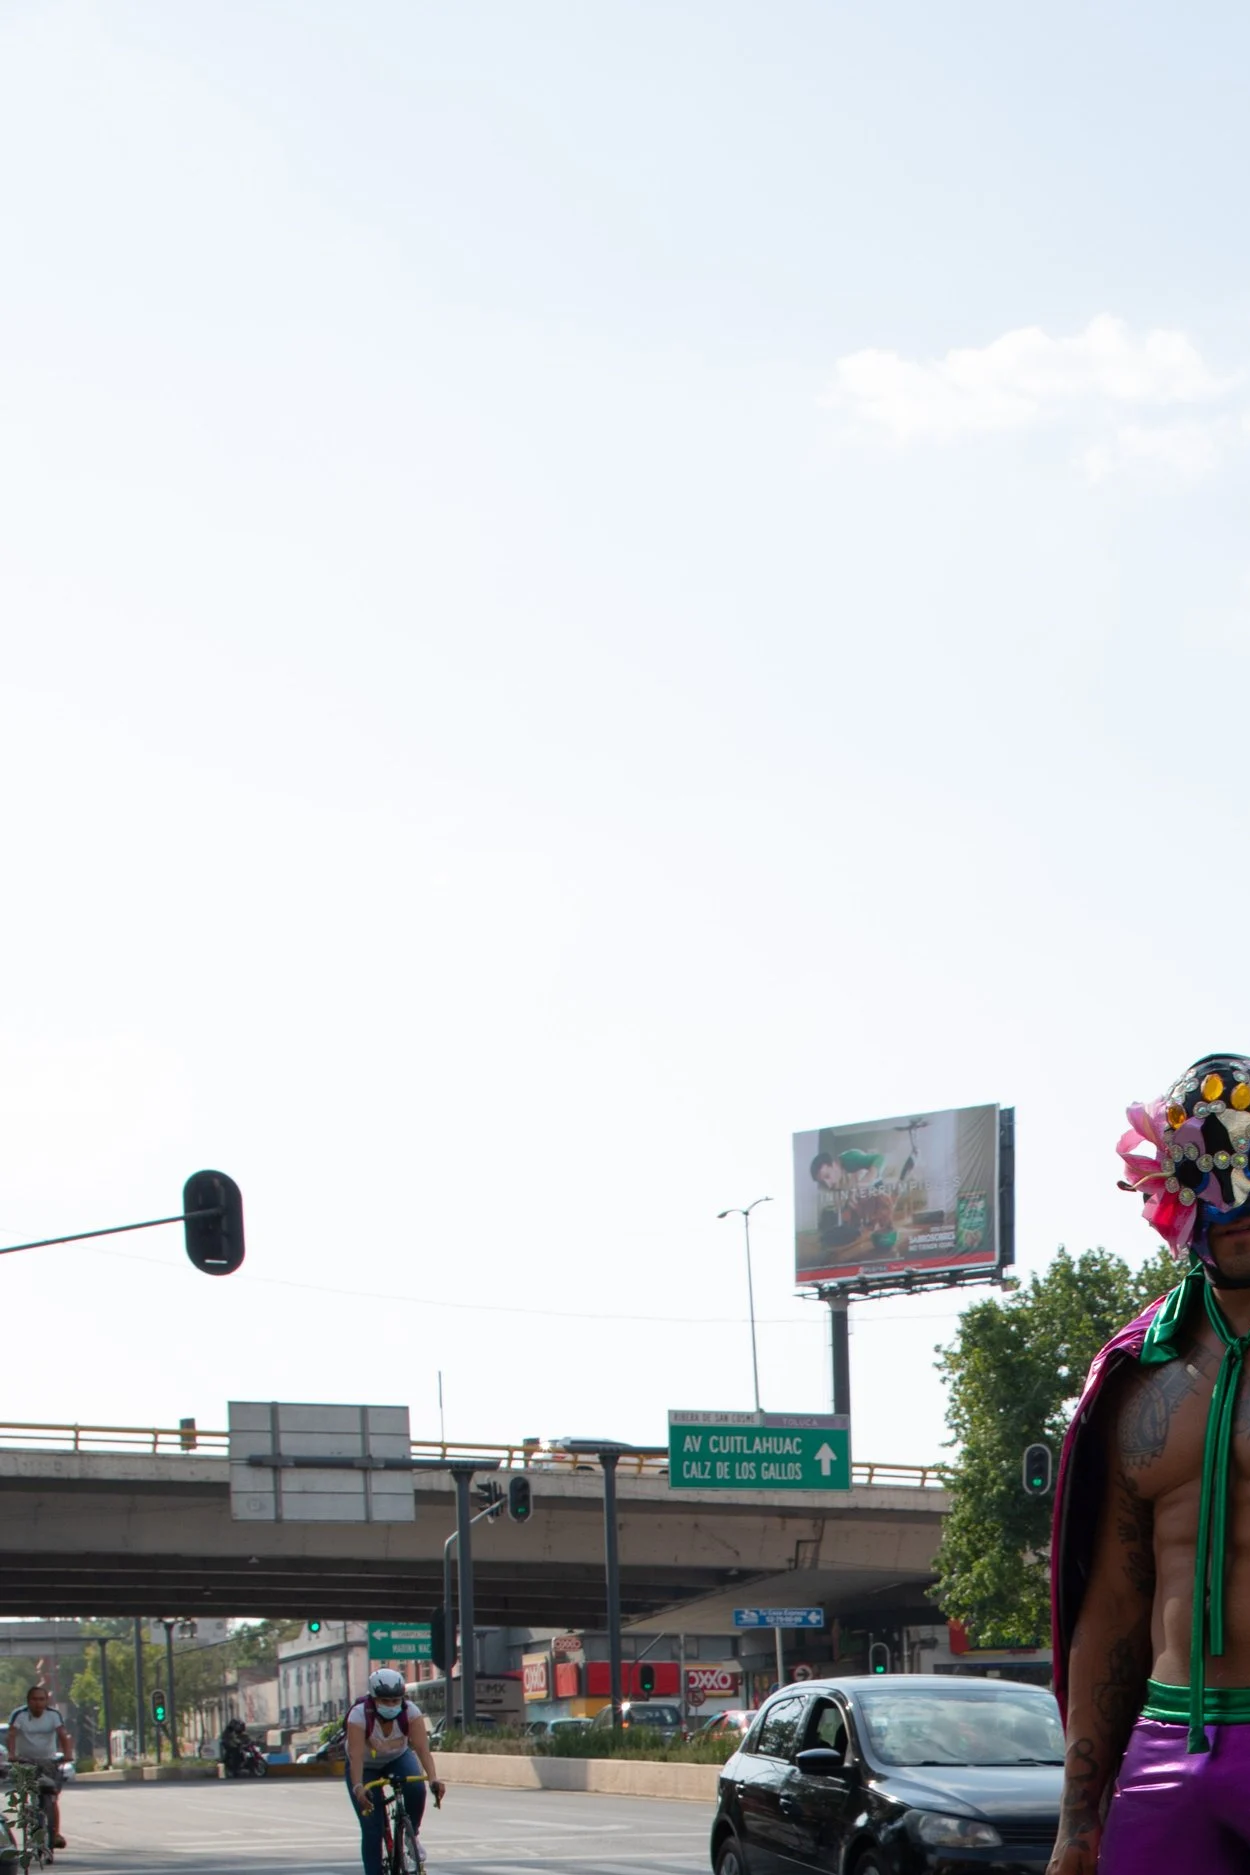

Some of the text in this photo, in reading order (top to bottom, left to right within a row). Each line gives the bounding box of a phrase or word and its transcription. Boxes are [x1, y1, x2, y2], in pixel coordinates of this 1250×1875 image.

[673, 1413, 755, 1424] RIBERA DE SAN COSME
[782, 1417, 818, 1427] TOLUCA
[683, 1435, 803, 1455] AV CUITLAHUAC
[682, 1461, 803, 1480] CALZ DE LOS GALLOS
[418, 1644, 431, 1653] NAC
[555, 1639, 581, 1649] OXXO
[524, 1662, 546, 1693] OXXO
[688, 1668, 732, 1689] OXXO
[476, 1683, 506, 1693] DMX
